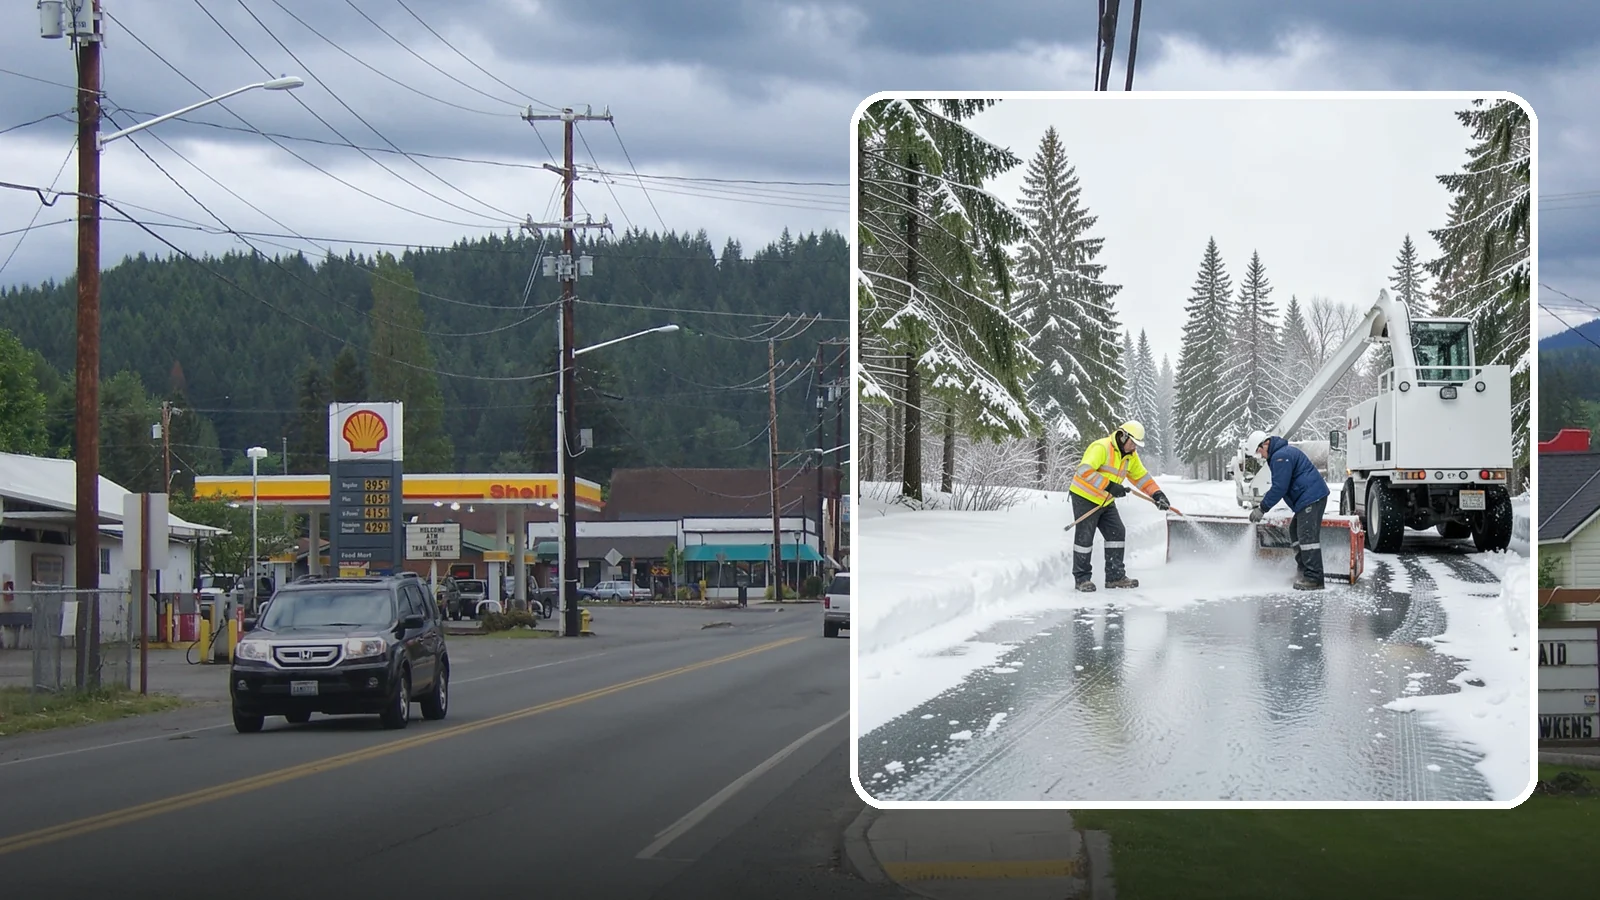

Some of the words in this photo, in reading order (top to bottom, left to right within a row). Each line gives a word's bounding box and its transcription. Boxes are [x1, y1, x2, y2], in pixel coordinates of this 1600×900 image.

[366, 480, 383, 490] 395
[490, 485, 547, 498] Shell
[366, 494, 383, 504] 405
[366, 508, 383, 518] 415
[366, 522, 383, 532] 429
